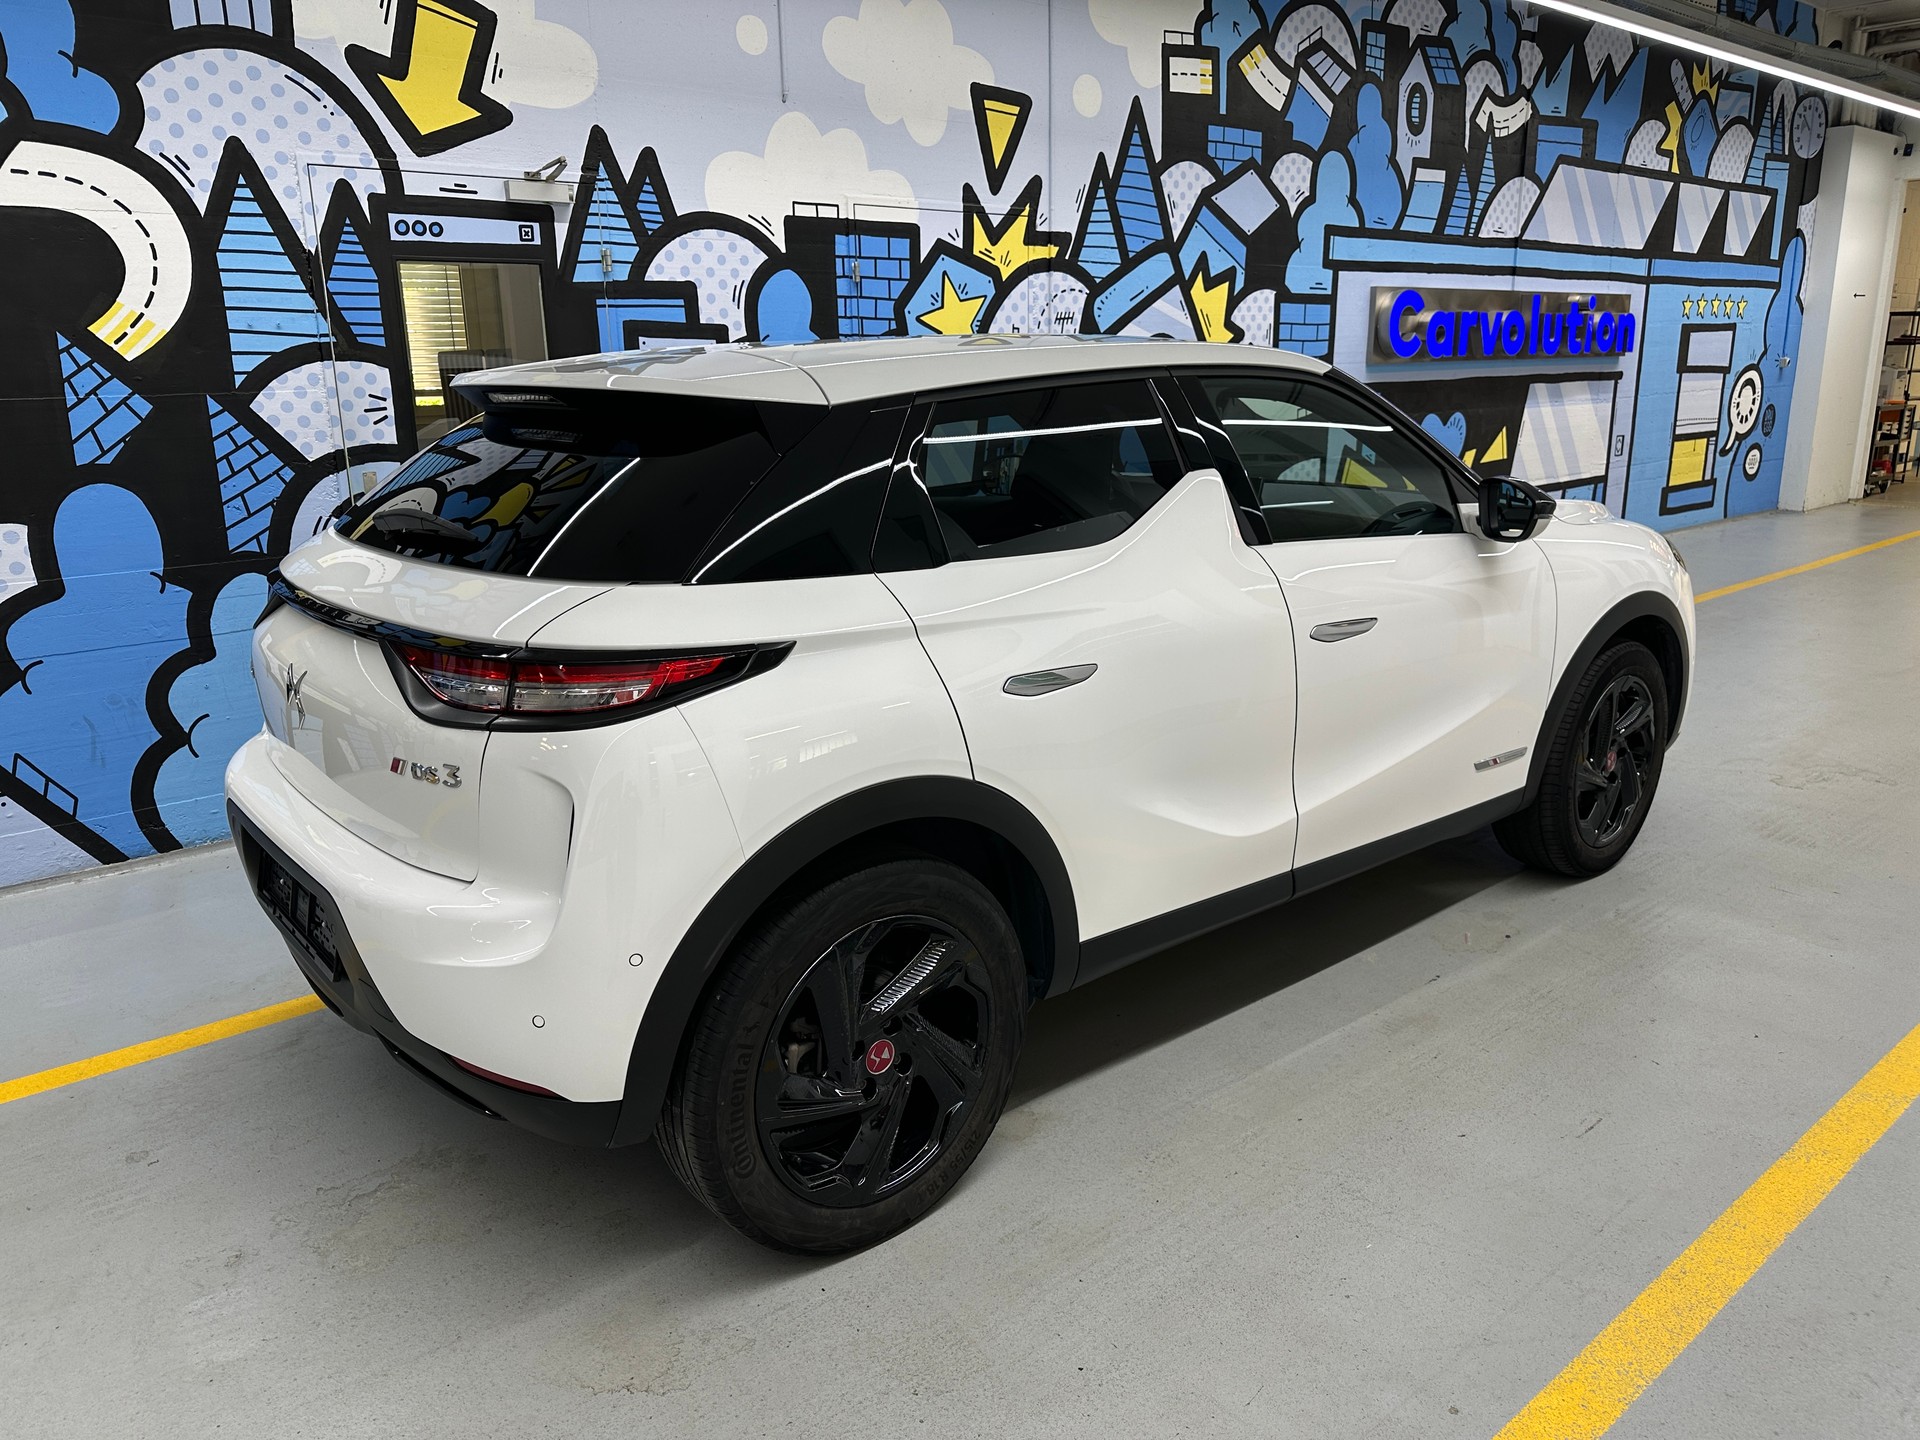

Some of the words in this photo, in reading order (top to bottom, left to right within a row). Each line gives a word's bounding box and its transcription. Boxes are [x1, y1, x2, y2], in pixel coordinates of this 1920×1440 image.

[1389, 289, 1637, 359] Carvolution
[410, 762, 441, 785] DS
[442, 763, 463, 789] 3
[727, 1043, 758, 1179] Continental
